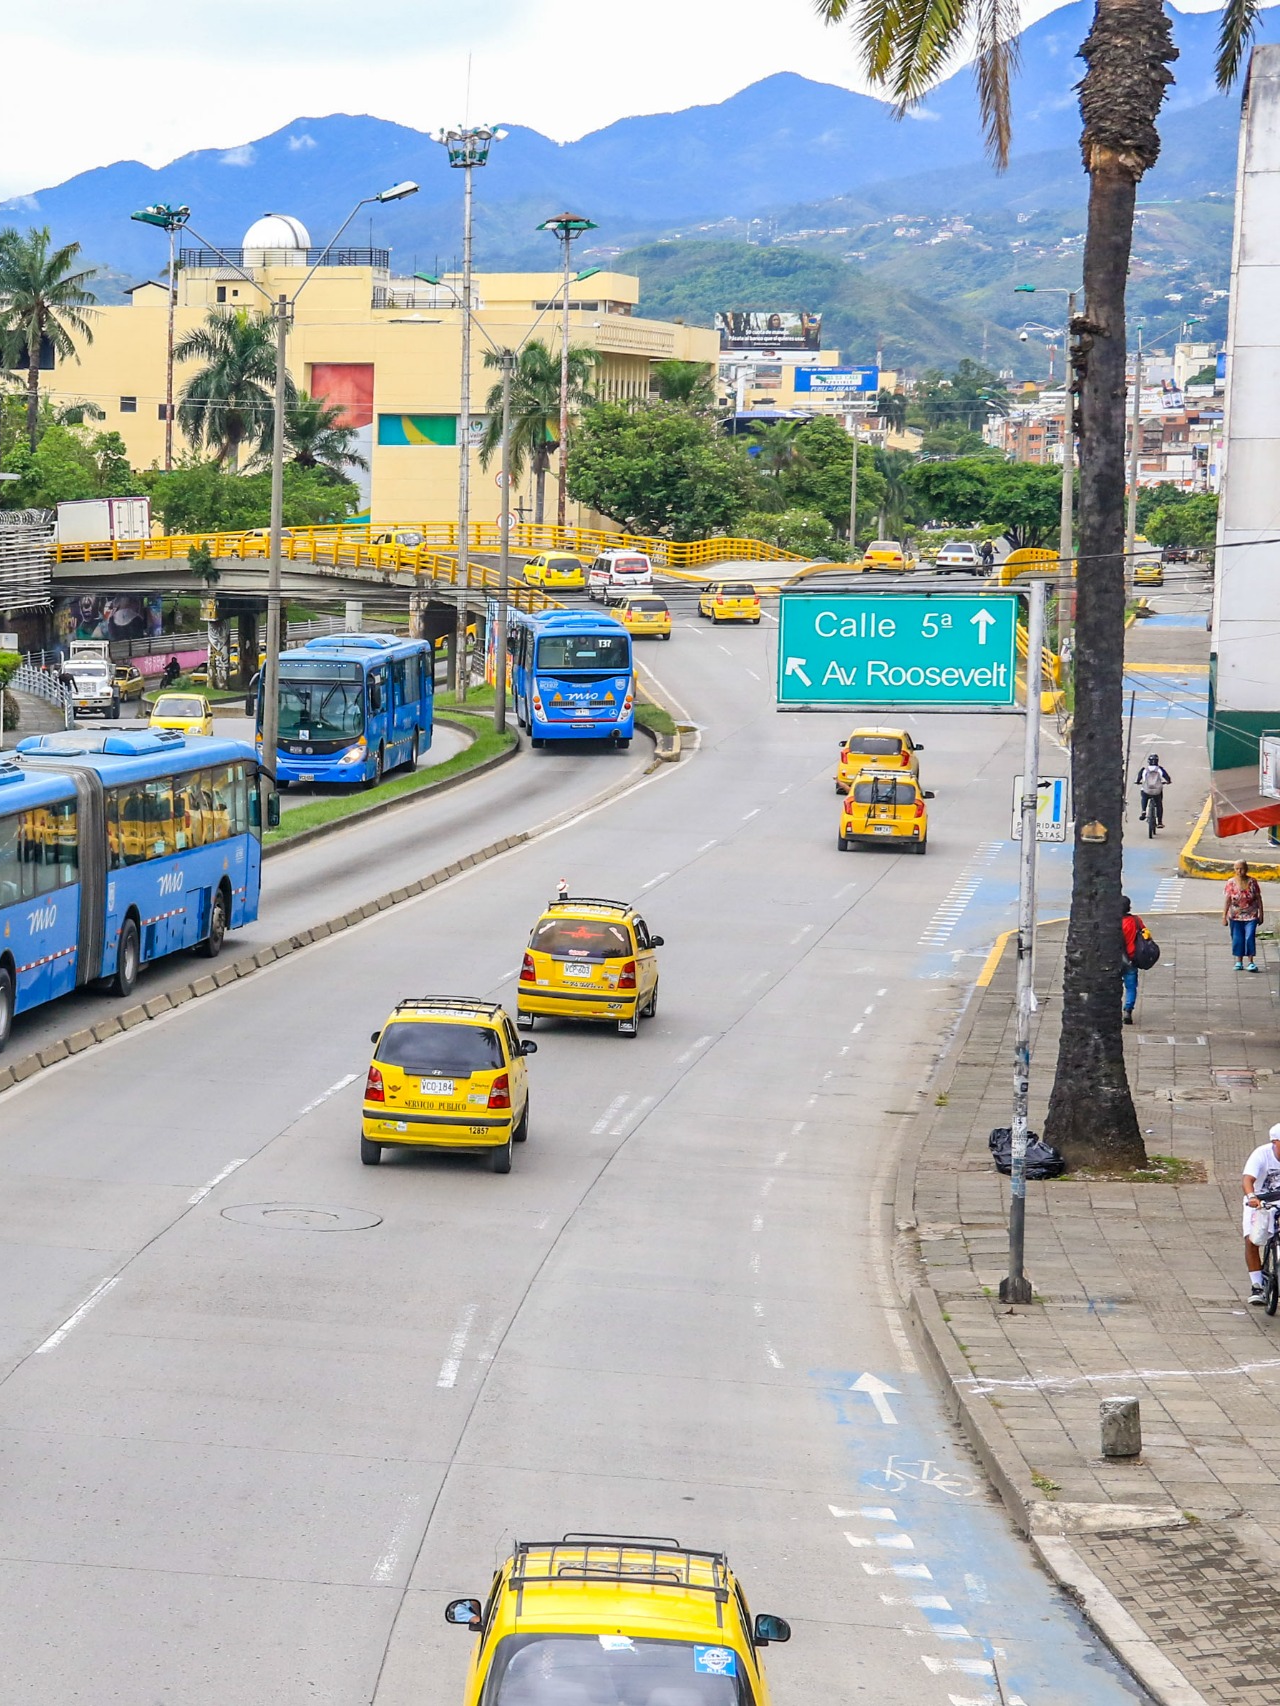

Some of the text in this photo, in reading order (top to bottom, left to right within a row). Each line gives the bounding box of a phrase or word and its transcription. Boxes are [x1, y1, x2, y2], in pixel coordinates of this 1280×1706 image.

[814, 611, 954, 638] Calle 5ª
[821, 660, 1008, 687] Av. Roosevelt
[404, 1100, 467, 1112] SERVICIO PUBLICO
[469, 1126, 489, 1135] 12857
